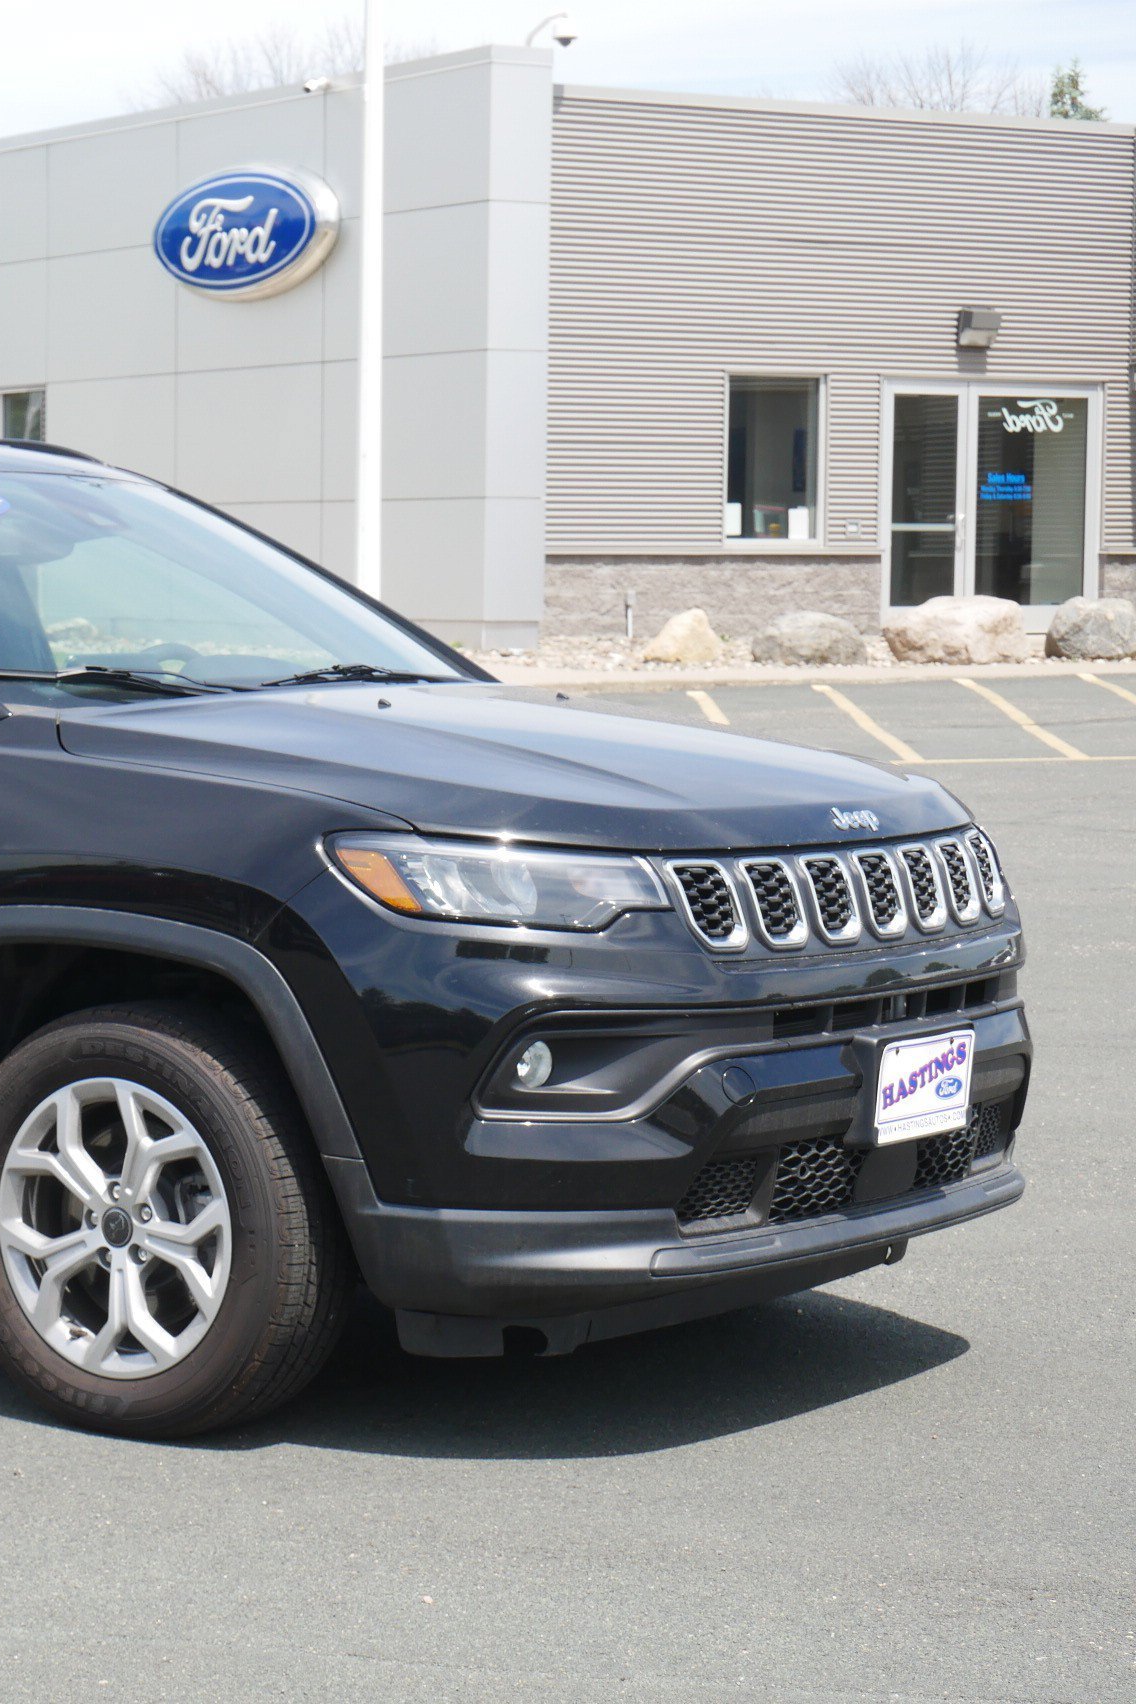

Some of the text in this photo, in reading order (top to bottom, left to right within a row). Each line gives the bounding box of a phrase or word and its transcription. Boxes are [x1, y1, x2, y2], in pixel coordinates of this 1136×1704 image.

[180, 195, 279, 272] Ford
[830, 806, 880, 832] Jeep
[882, 1042, 967, 1110] HASTINGS
[939, 1078, 959, 1096] Ford
